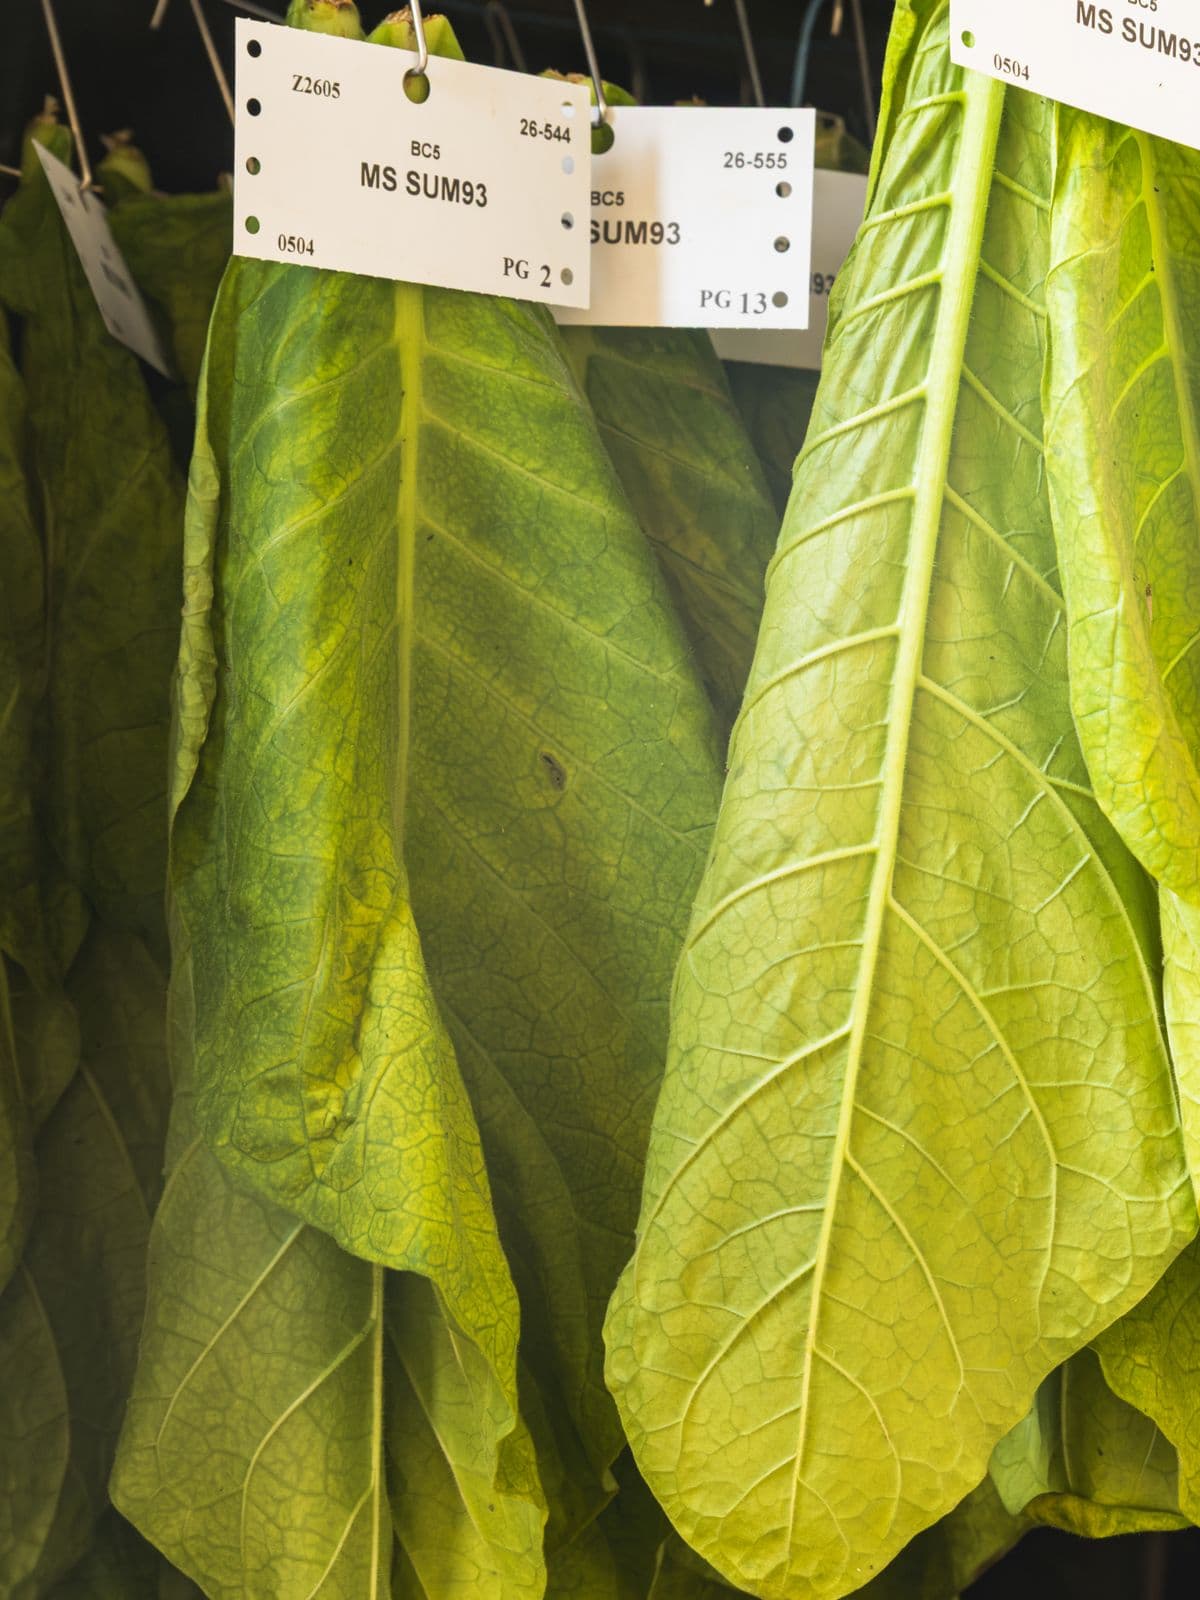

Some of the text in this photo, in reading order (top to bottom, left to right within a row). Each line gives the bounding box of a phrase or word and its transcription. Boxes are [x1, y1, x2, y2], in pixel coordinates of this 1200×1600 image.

[1076, 0, 1113, 34] MS
[993, 53, 1030, 80] 0504
[292, 74, 341, 99] Z2605
[520, 118, 571, 144] 26-544
[411, 140, 441, 160] BC5
[723, 152, 787, 169] 26-555
[361, 162, 488, 208] MS SUM93
[591, 190, 624, 206] BC5
[278, 233, 315, 256] 0504
[590, 220, 680, 245] SUM93
[503, 257, 551, 287] PG 2
[700, 290, 767, 314] PG 13
